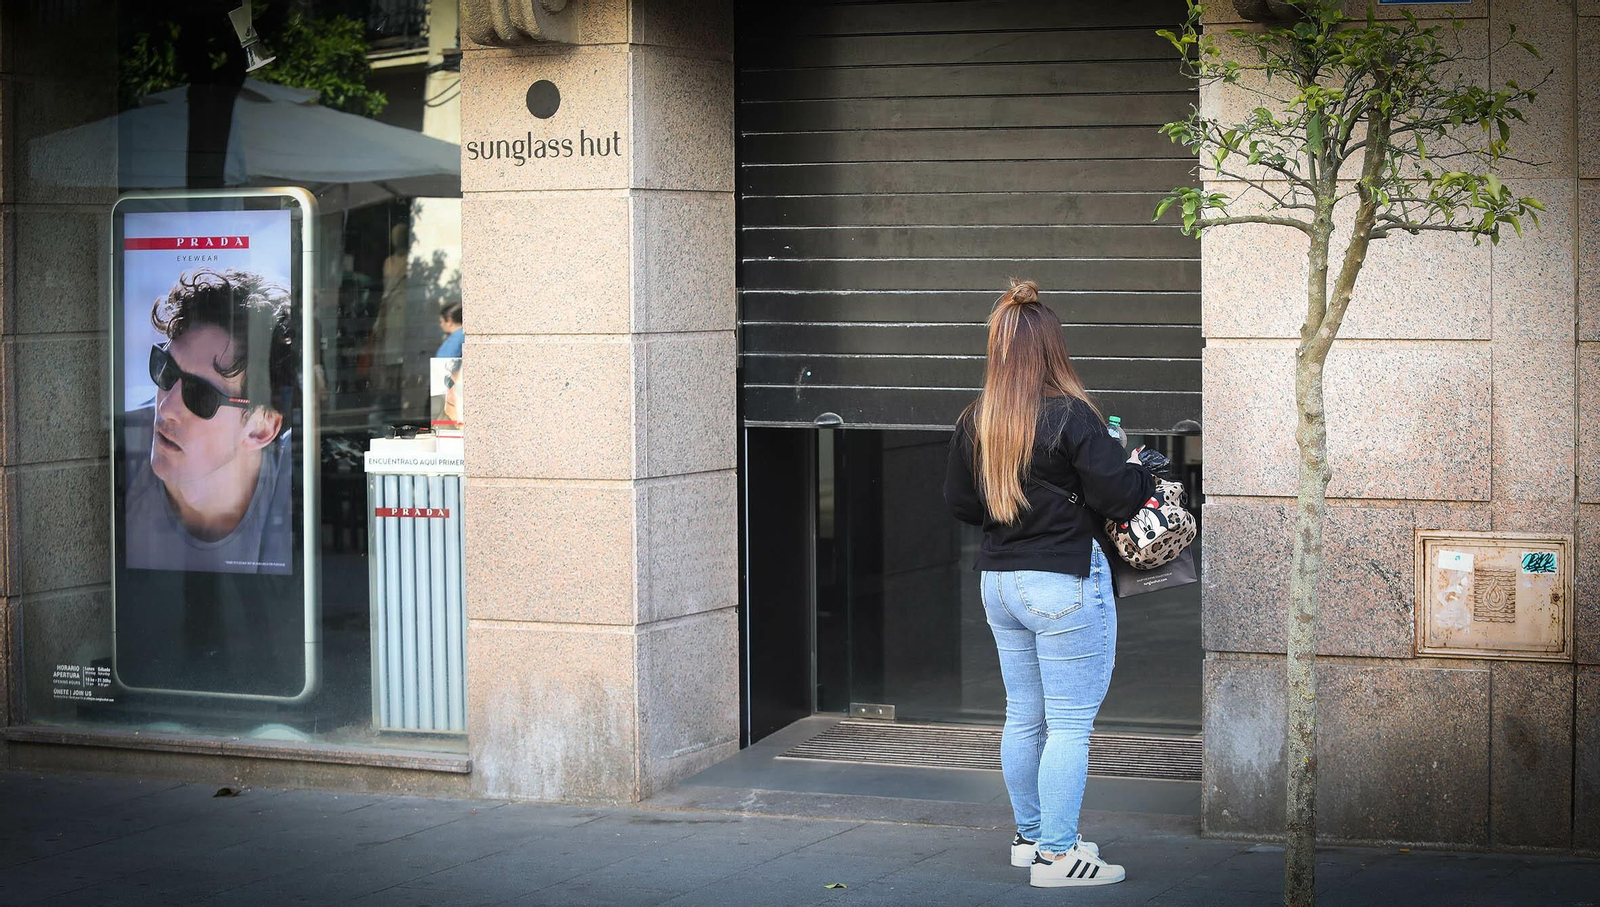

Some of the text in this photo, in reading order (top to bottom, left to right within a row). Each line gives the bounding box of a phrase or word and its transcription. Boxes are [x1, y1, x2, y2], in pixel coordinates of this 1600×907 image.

[466, 129, 622, 167] sunglass hut
[176, 237, 244, 247] PRADA
[391, 507, 445, 516] PRADA
[56, 664, 80, 672] HORARIO
[53, 671, 80, 679] APERTURA
